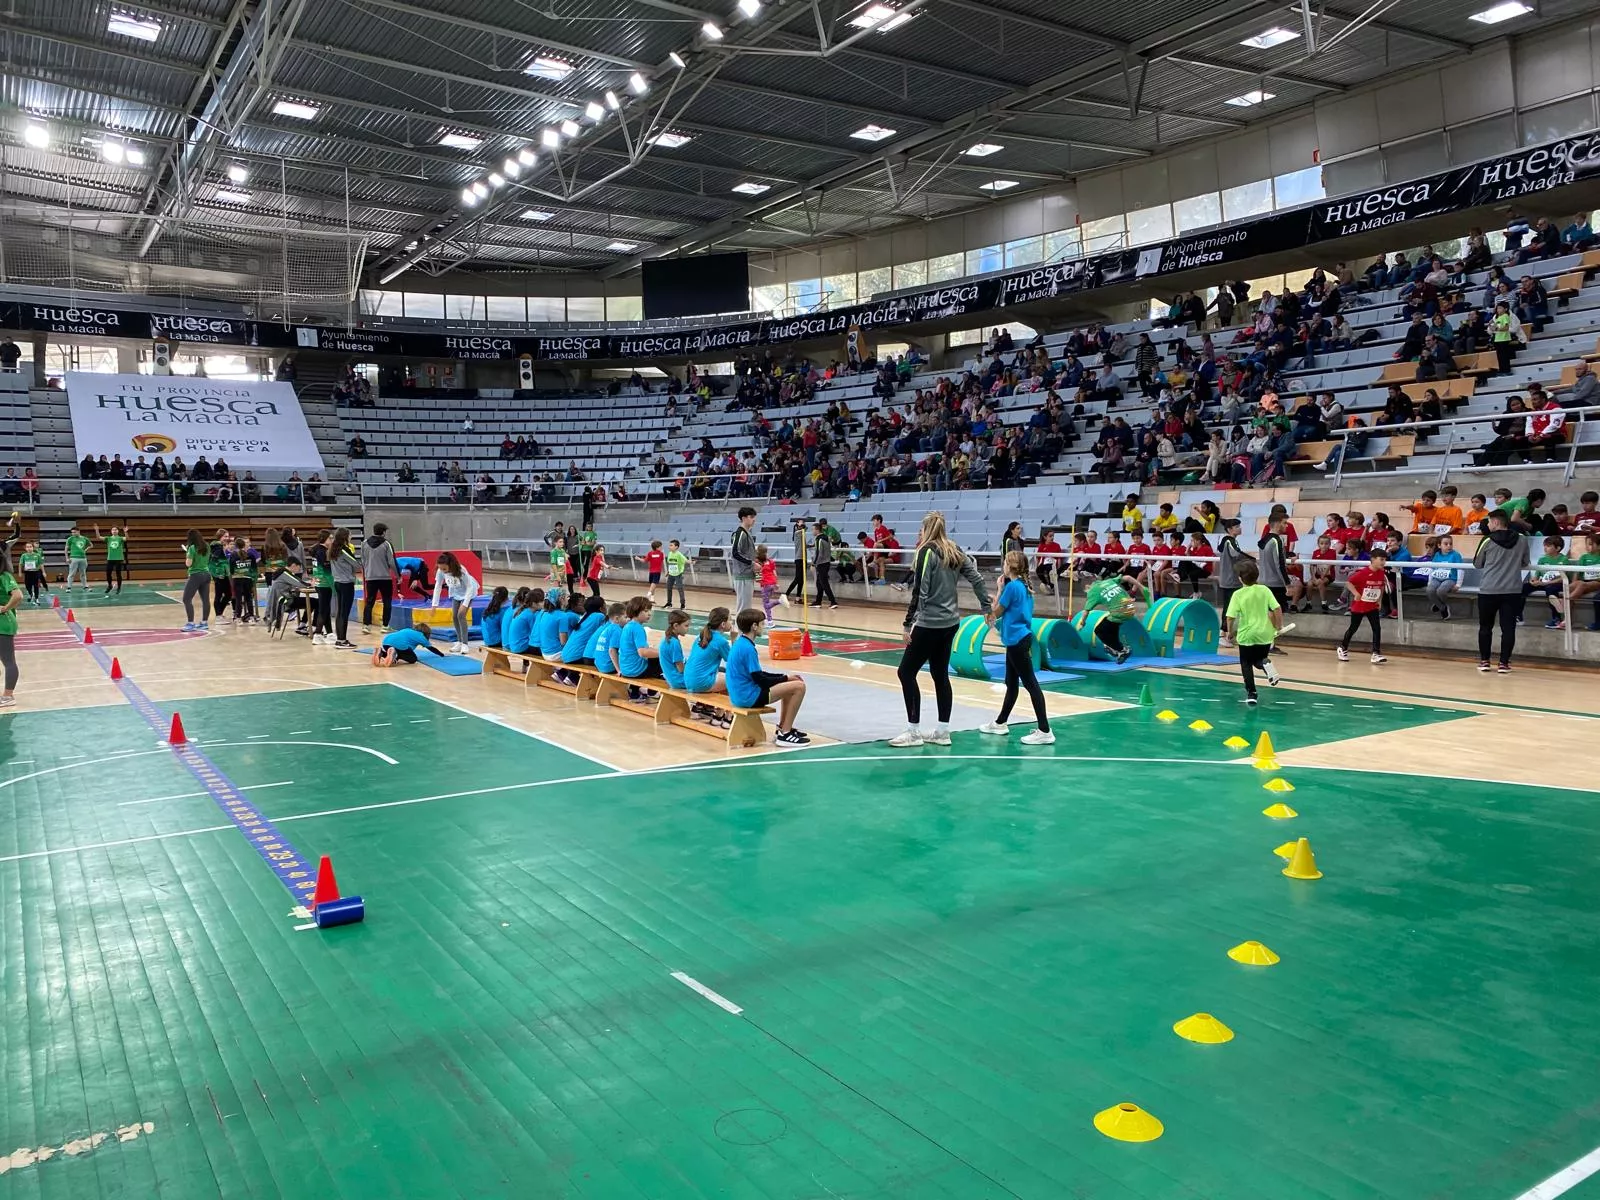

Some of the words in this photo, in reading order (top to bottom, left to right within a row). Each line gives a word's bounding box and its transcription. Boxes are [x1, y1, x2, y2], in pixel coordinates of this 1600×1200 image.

[1324, 183, 1430, 223] Huesca
[1165, 230, 1248, 258] Ayuntamiento
[1161, 259, 1176, 273] de
[1178, 250, 1224, 268] Huesca
[1005, 263, 1075, 292] Huesca
[33, 306, 120, 325] Huesca
[153, 315, 233, 334] Huesca
[321, 329, 390, 344] Ayuntamiento
[769, 318, 826, 340] Huesca
[321, 340, 335, 349] de
[337, 341, 374, 352] Huesca
[446, 337, 511, 350] Huesca
[539, 337, 601, 350] Huesca
[620, 337, 681, 353] Huesca
[95, 393, 283, 416] Huesca
[186, 445, 271, 453] HUESCA
